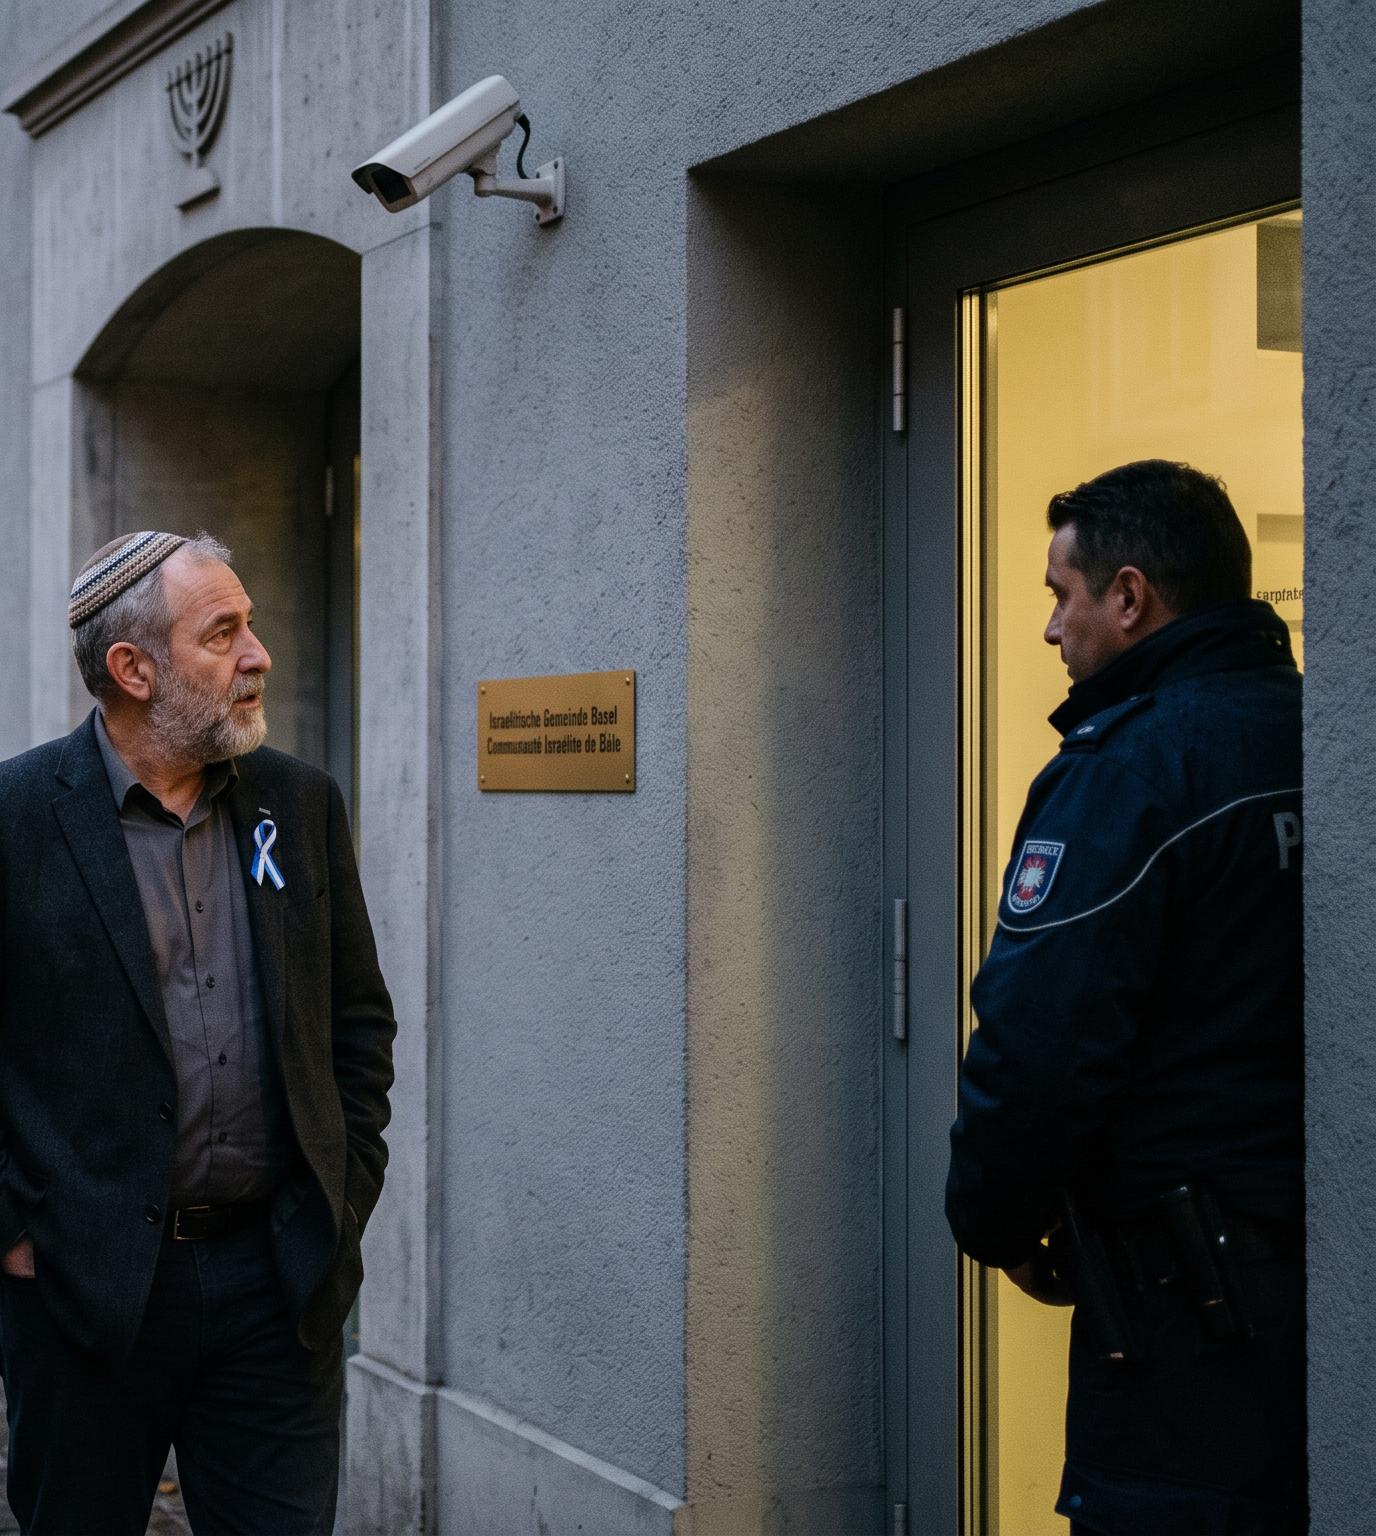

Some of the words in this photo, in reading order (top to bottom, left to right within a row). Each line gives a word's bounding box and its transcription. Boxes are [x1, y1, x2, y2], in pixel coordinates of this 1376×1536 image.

[544, 708, 588, 727] Gemeinde
[591, 706, 617, 726] Basel
[585, 733, 596, 753] de
[1272, 811, 1302, 869] P
